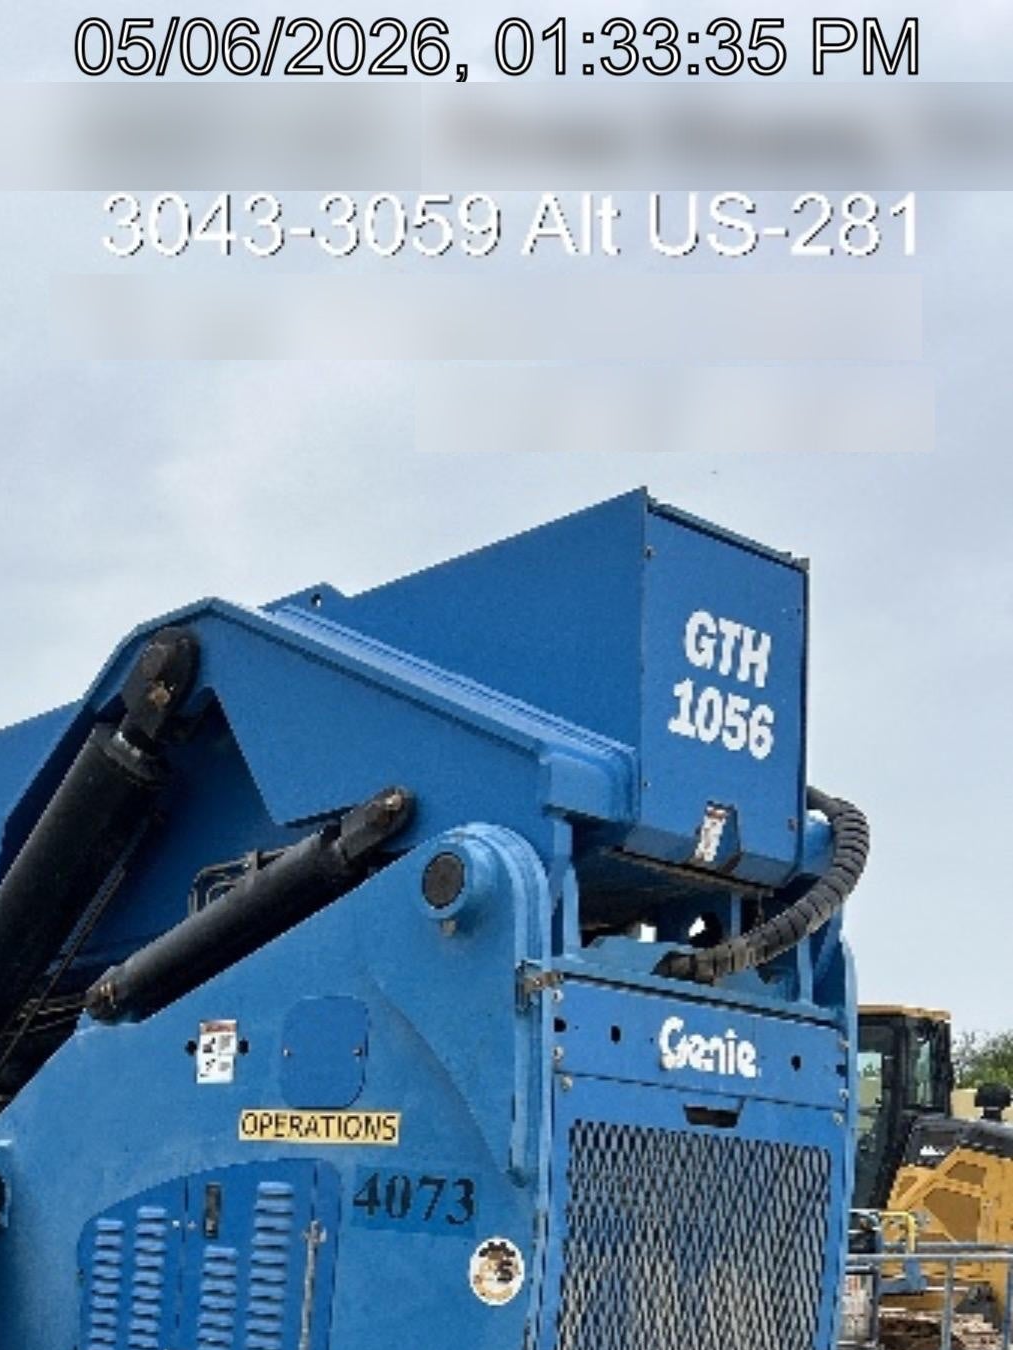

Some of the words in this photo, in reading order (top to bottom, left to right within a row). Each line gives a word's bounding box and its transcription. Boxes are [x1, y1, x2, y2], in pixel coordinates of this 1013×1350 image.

[685, 610, 771, 688] GTH
[668, 678, 774, 760] 1056
[658, 1016, 757, 1078] Genie
[241, 1112, 397, 1142] OPERATIONS
[353, 1172, 475, 1225] 4073
